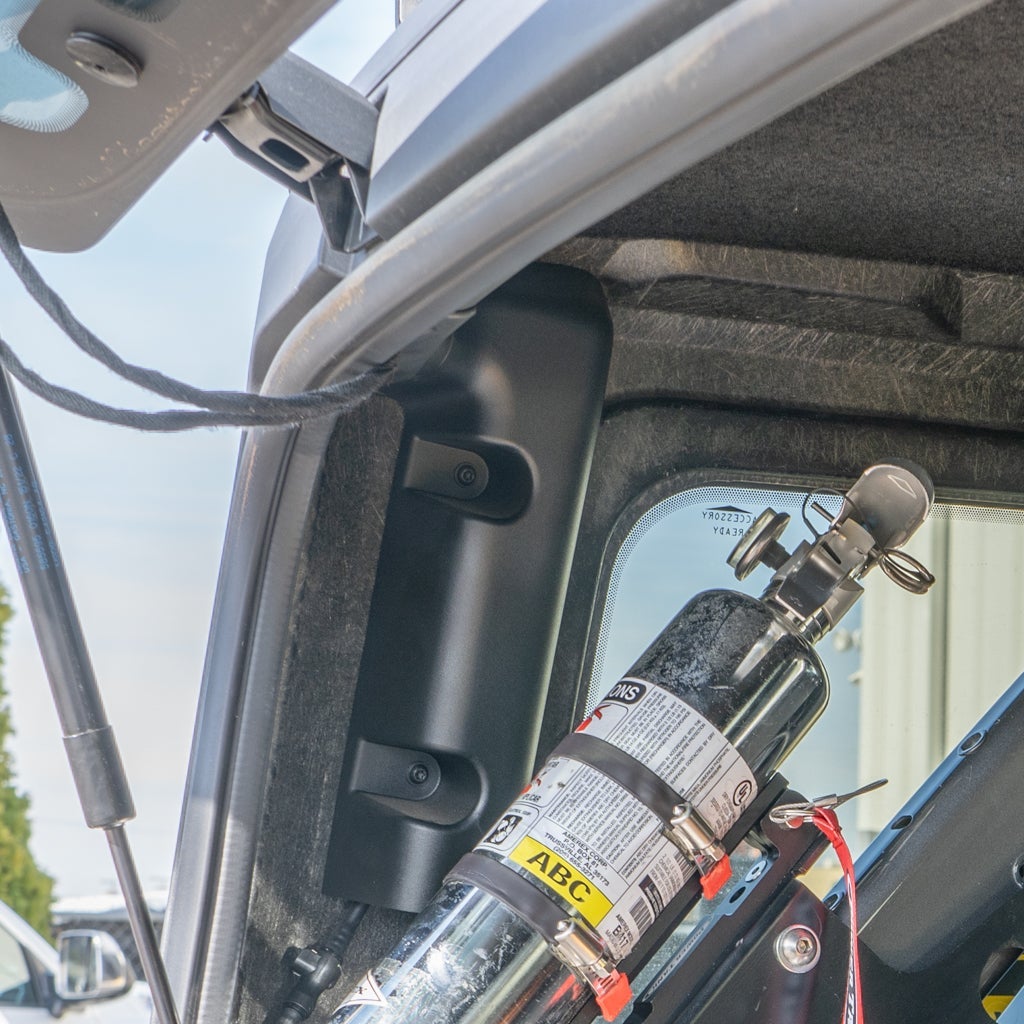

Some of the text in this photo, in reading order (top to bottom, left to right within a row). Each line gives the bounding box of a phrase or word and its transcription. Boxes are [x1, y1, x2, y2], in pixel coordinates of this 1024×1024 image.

[561, 830, 609, 869] AMEREX CORP.
[576, 848, 591, 861] BOX
[590, 859, 599, 868] 81
[526, 850, 591, 903] ABC
[567, 856, 595, 880] 655-3271
[583, 861, 593, 871] AL
[591, 869, 610, 887] 35173
